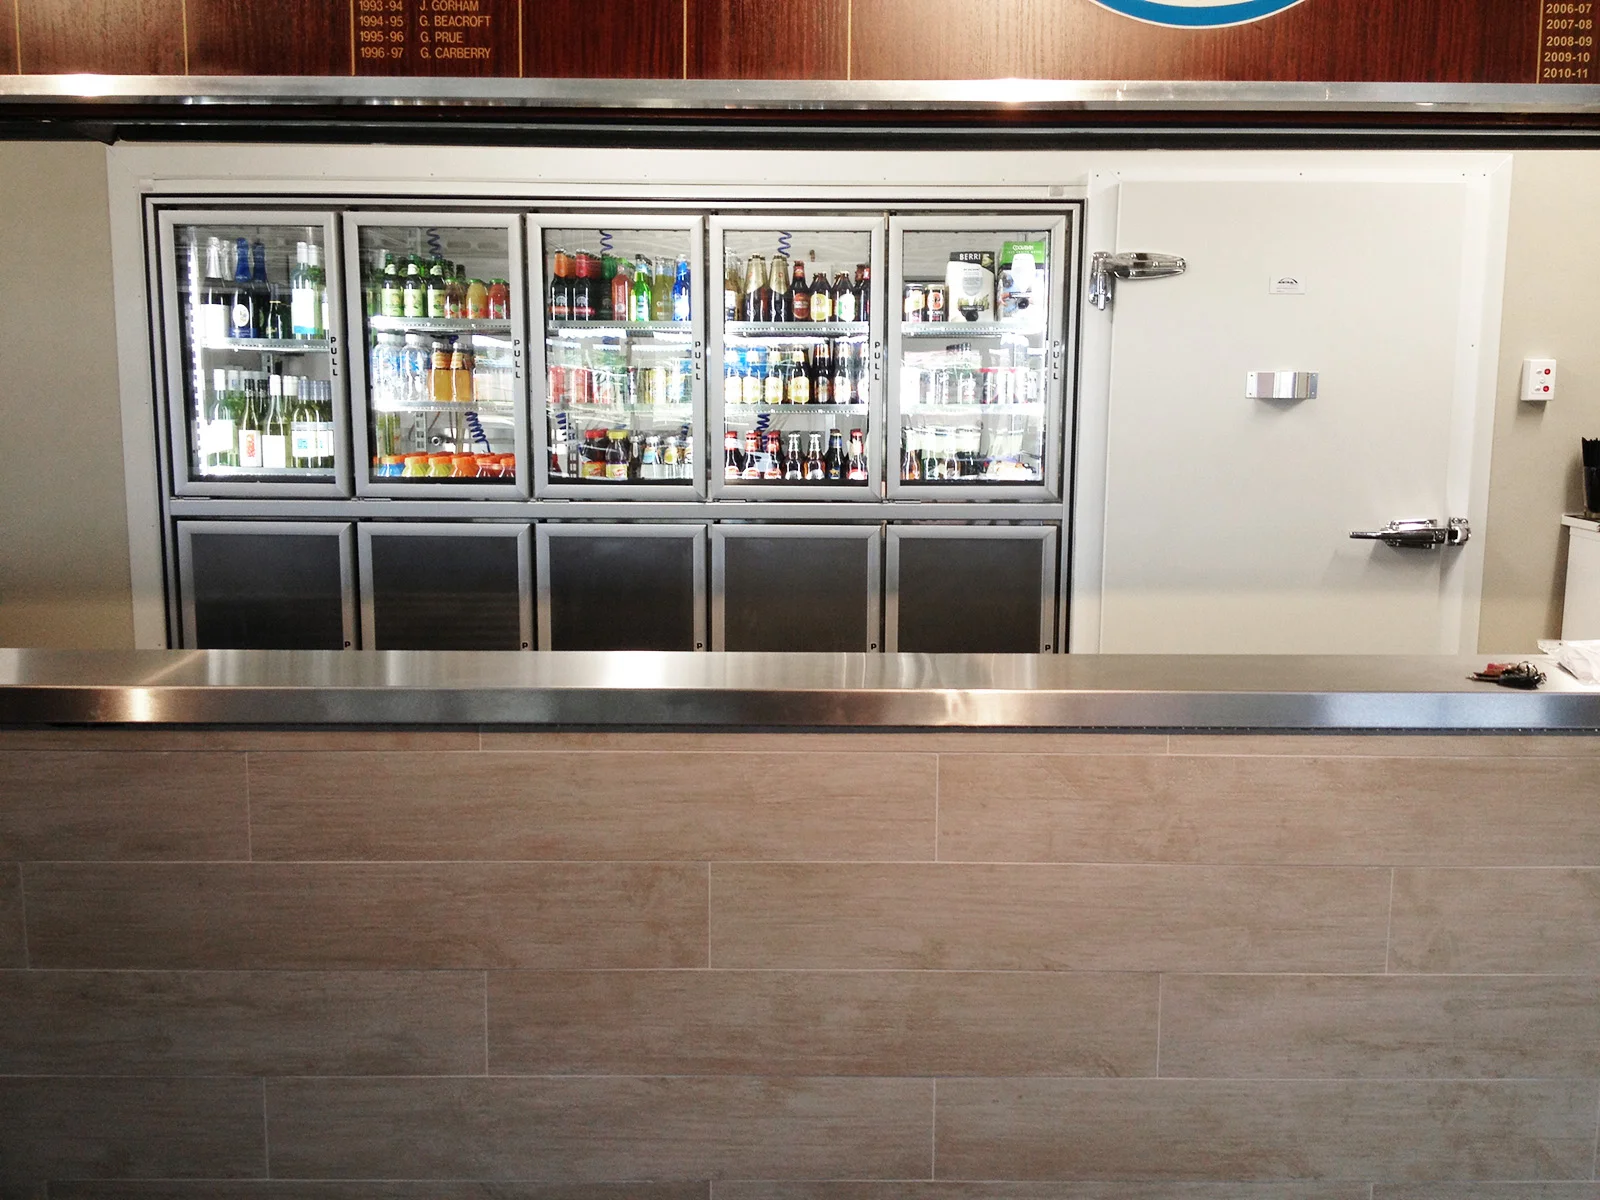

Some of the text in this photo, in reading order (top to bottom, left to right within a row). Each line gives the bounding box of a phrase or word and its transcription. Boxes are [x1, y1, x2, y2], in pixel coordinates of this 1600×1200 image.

[420, 0, 428, 11] J.
[431, 0, 479, 11] GORHAM
[1546, 3, 1592, 13] 2006-07
[360, 16, 491, 27] 1994-95 G. BEACROFT
[1546, 19, 1593, 30] 2007-08
[360, 31, 463, 43] 1995-96 G. PRUE
[1546, 36, 1593, 47] 2008-09
[360, 47, 491, 58] 1996-97 G. CARBERRY
[1544, 52, 1590, 62] 2009-10
[1543, 68, 1588, 78] 2010-11
[959, 253, 981, 261] BERRI
[330, 336, 338, 376] PULL
